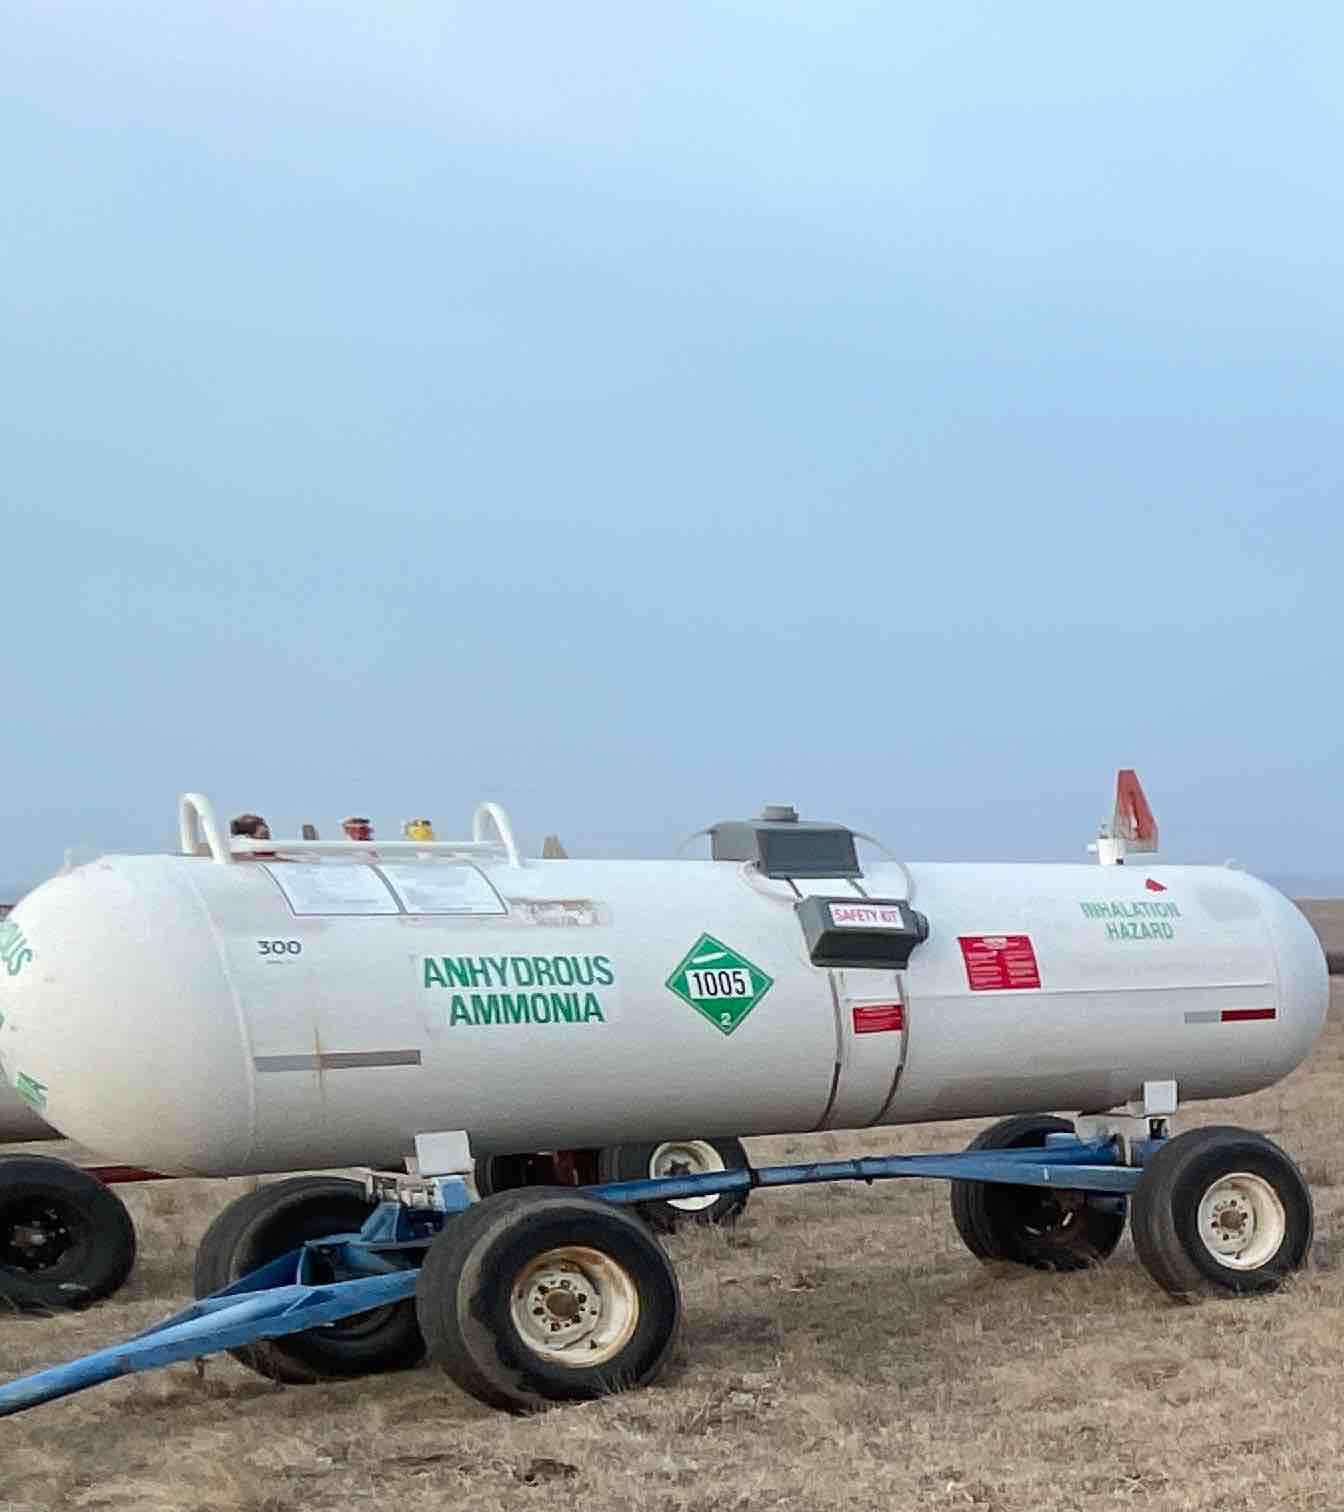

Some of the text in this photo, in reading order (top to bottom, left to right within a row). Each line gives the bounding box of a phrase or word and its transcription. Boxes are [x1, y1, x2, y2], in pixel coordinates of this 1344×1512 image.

[833, 909, 898, 922] SAFETY KIT
[1105, 922, 1176, 940] HAZARD
[257, 940, 302, 956] 300
[423, 954, 615, 990] ANHYDROUS
[692, 971, 746, 997] 1005
[448, 991, 605, 1027] AMMONIA
[720, 1012, 733, 1027] 2
